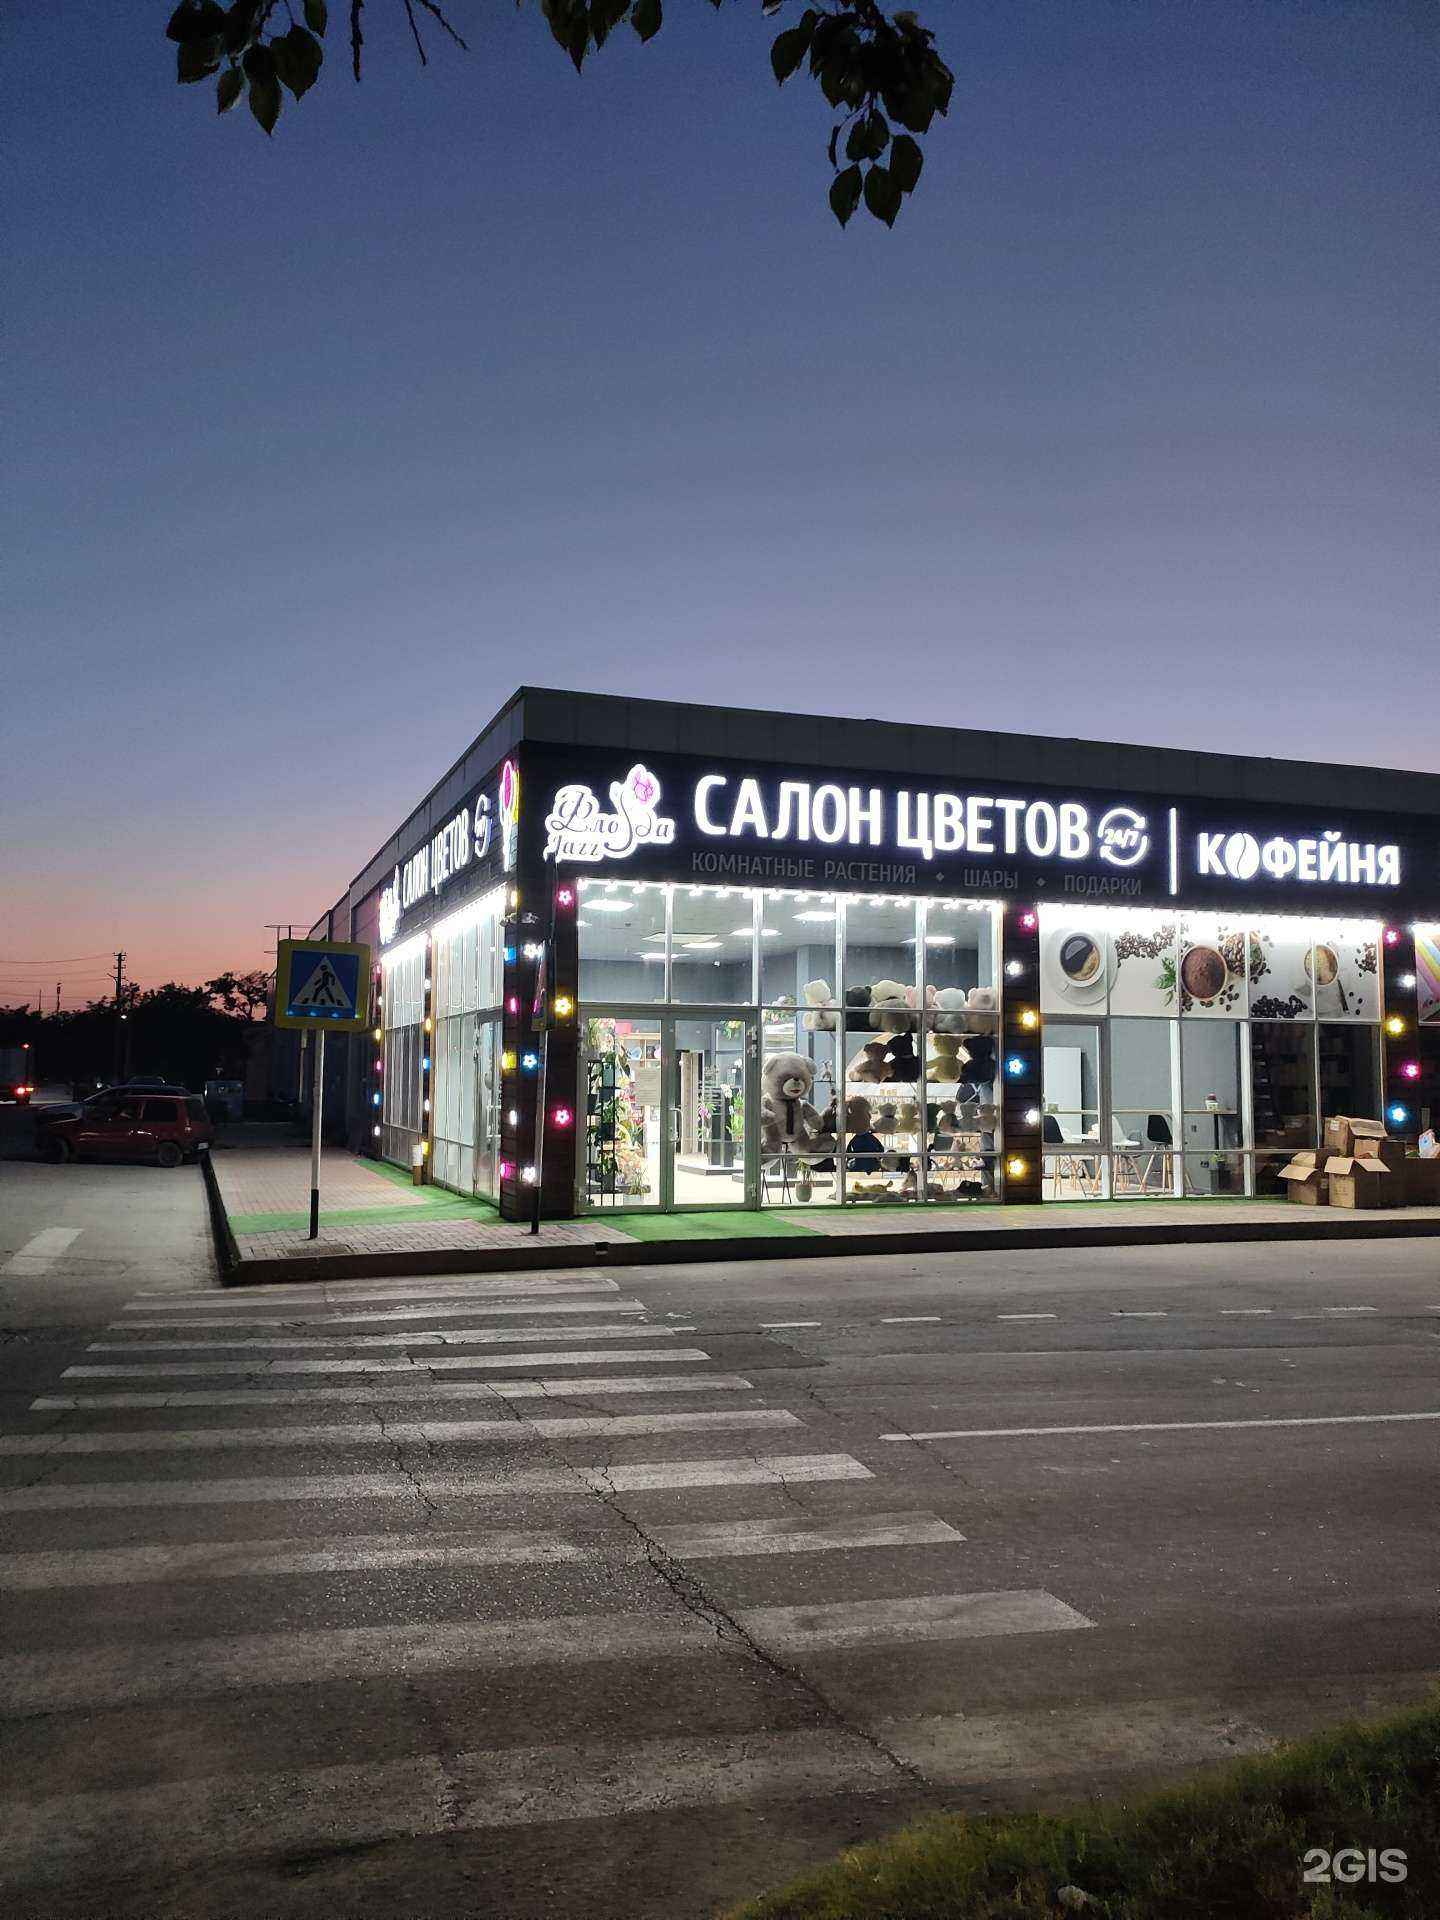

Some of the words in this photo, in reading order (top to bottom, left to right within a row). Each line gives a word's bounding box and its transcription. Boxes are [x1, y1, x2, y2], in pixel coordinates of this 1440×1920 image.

[693, 773, 882, 847] САЛОН
[895, 789, 1091, 861] ЦВЕТОВ
[1102, 827, 1140, 849] 24/7
[691, 852, 815, 880] КОМНАТНЫЕ
[824, 859, 917, 885] РАСТЕНИЯ
[963, 868, 1019, 890] ШАРЫ
[1064, 874, 1143, 896] ПОДАРКИ
[1198, 830, 1401, 886] КОФЕЙНЯ
